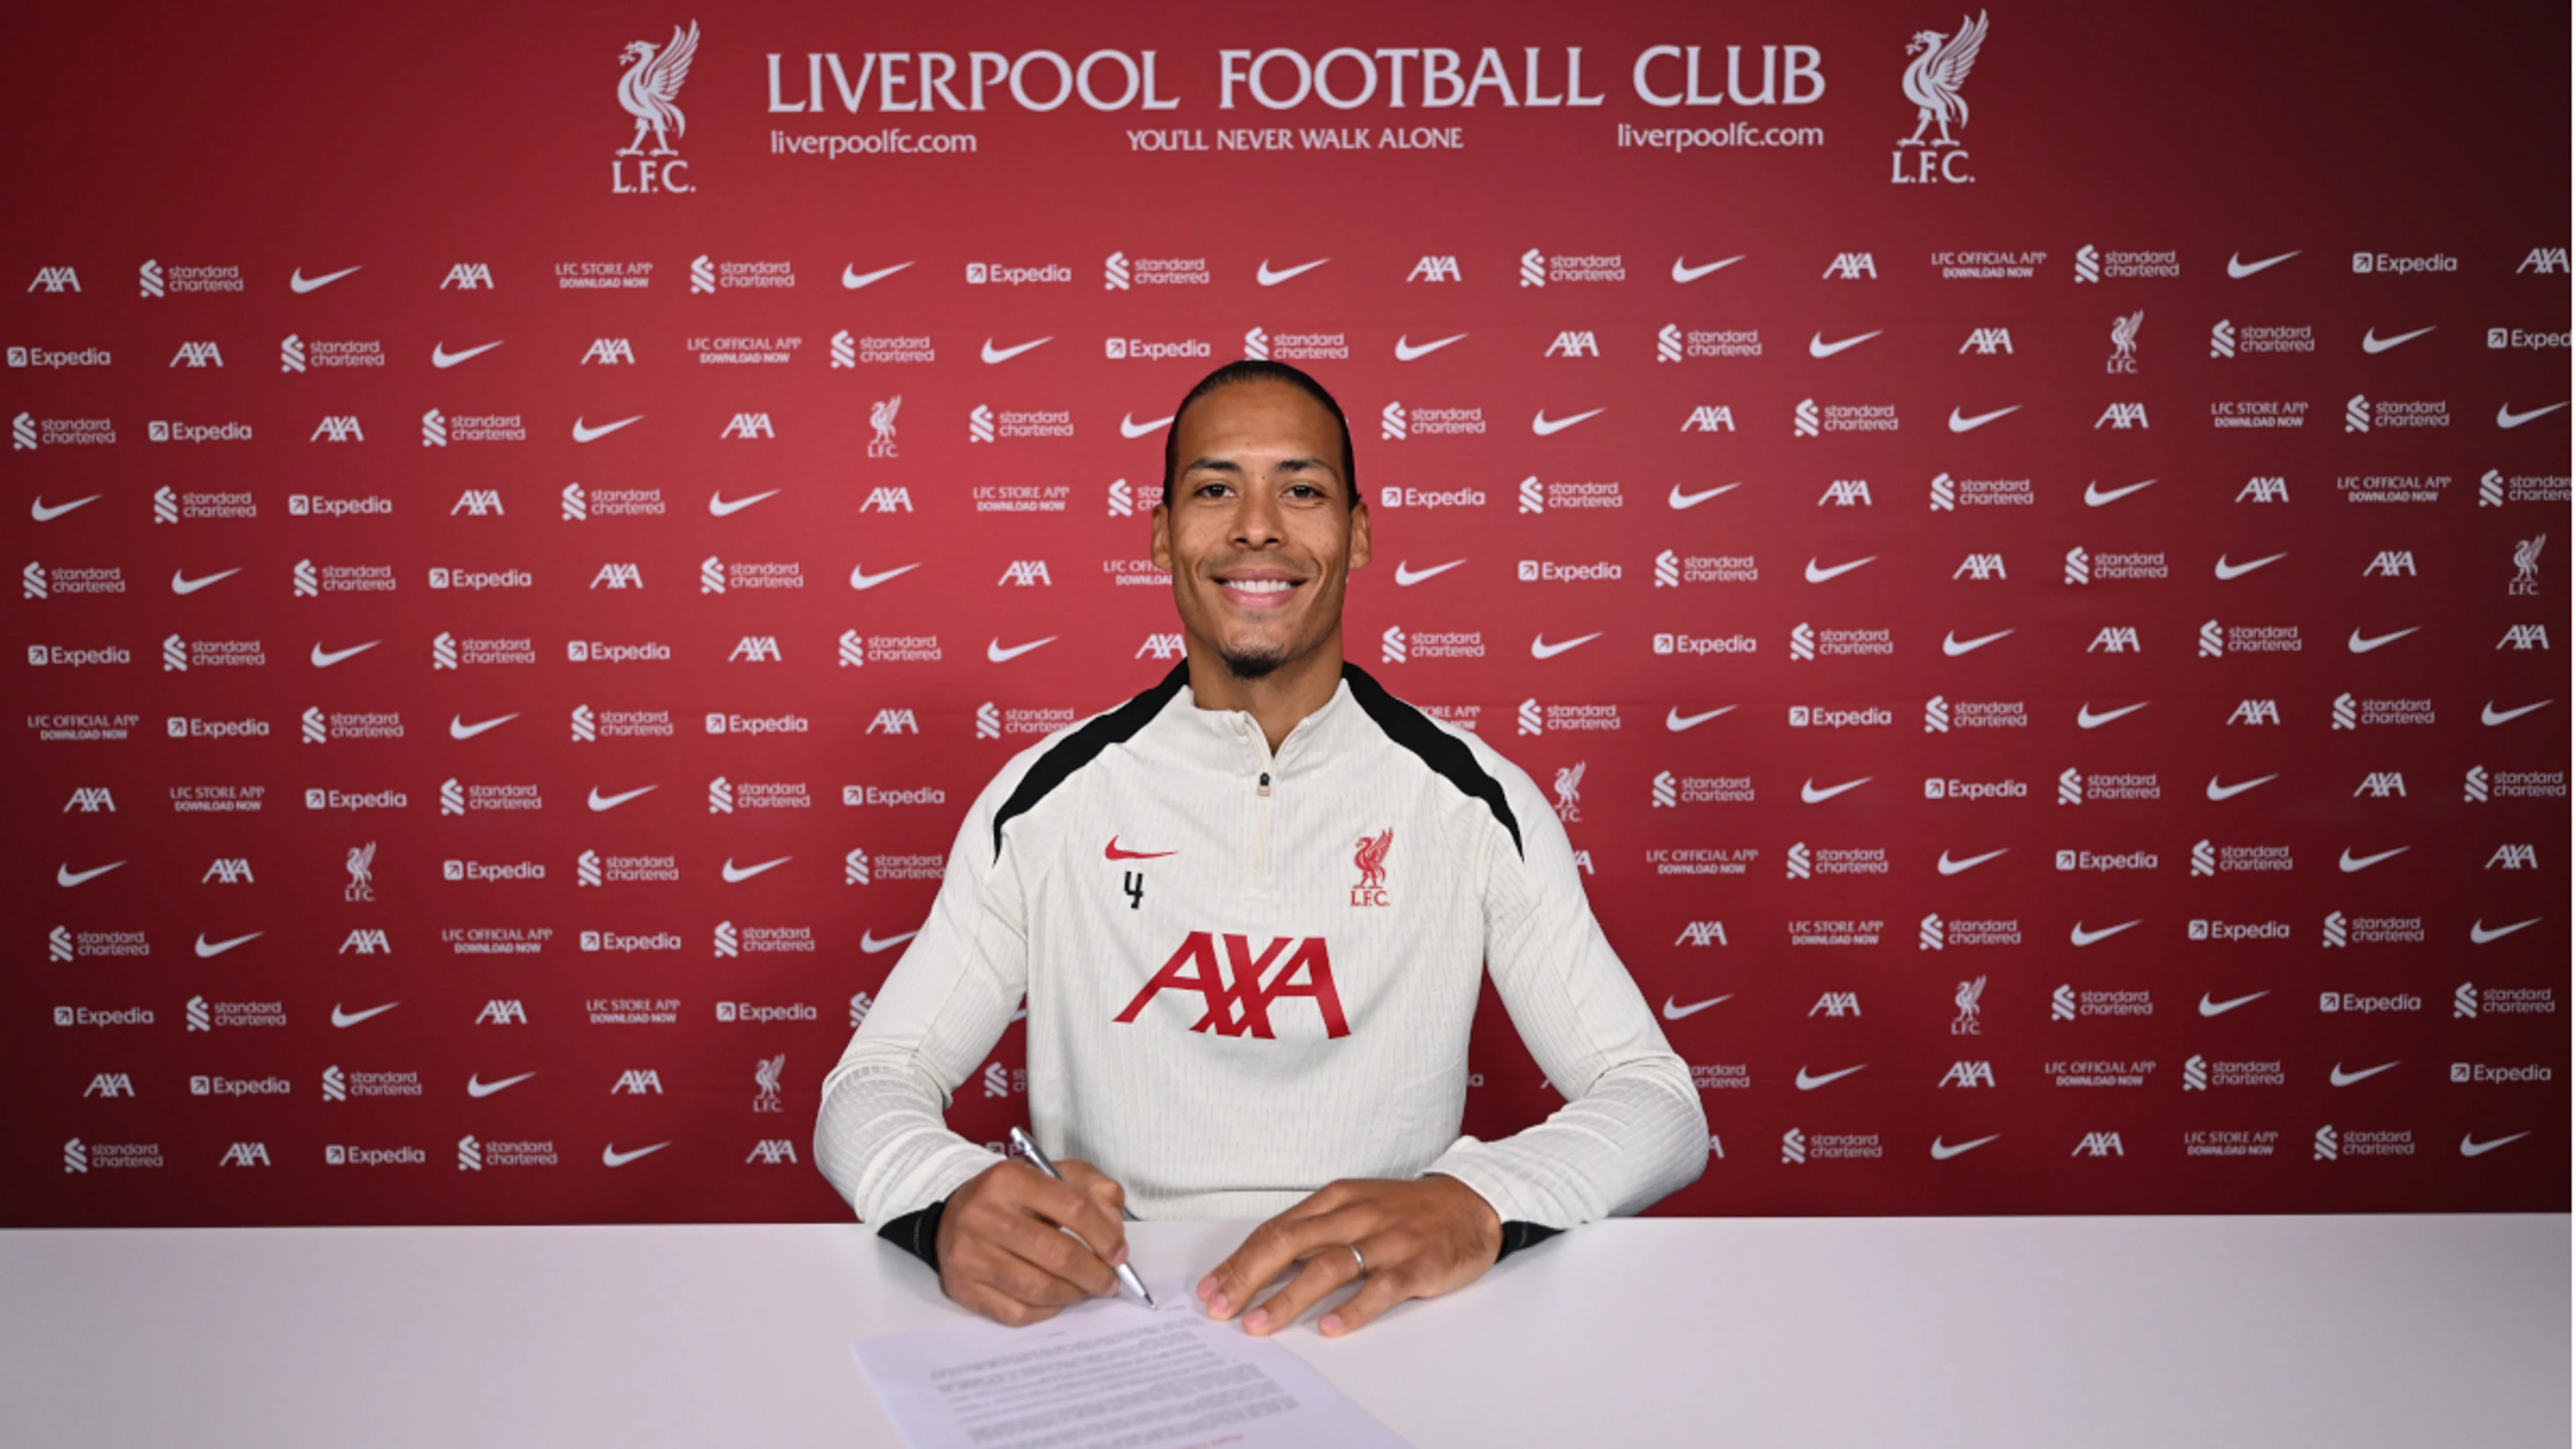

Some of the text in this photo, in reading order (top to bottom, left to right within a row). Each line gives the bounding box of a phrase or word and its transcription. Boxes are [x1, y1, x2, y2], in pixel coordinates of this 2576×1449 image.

[767, 45, 1825, 113] LIVERPOOL FOOTBALL CLUB
[771, 129, 977, 160] liverpoolfc.com
[1127, 127, 1464, 150] YOU'LL NEVER WALK ALONE
[1618, 122, 1823, 152] liverpoolfc.com
[612, 161, 696, 193] L.F.C.
[1891, 152, 1975, 183] L.F.C.
[1134, 258, 1205, 271] standard
[1823, 253, 1877, 279] AXA
[1931, 252, 2047, 265] LFC OFFICIAL APP
[2105, 250, 2176, 264] standard
[2377, 254, 2457, 275] Expedia
[2516, 248, 2569, 273] AXA
[169, 266, 239, 278] standard
[440, 264, 494, 289] AXA
[555, 262, 653, 275] LFC STORE APP
[990, 264, 1071, 285] Expedia
[1134, 271, 1210, 284] chartered
[1407, 256, 1461, 282] AXA
[1943, 268, 2033, 278] DOWNLOAD NOW
[2104, 264, 2179, 277] chartered
[28, 267, 81, 292] AXA
[170, 278, 244, 292] chartered
[560, 277, 649, 288] DOWNLOAD NOW
[687, 337, 802, 350] LFC OFFICIAL APP
[860, 336, 930, 349] standard
[1545, 331, 1599, 357] AXA
[1687, 330, 1758, 343] standard
[1960, 328, 2013, 354] AXA
[2511, 328, 2572, 350] Exped
[31, 347, 111, 369] Expedia
[170, 341, 223, 367] AXA
[581, 339, 635, 364] AXA
[700, 352, 790, 364] DOWNLOAD NOW
[860, 349, 934, 362] chartered
[1130, 339, 1211, 360] Expedia
[1687, 343, 1762, 356] chartered
[1411, 408, 1481, 421] standard
[1681, 406, 1735, 431] AXA
[2095, 403, 2149, 429] AXA
[2211, 402, 2308, 415] LFC STORE APP
[311, 416, 364, 441] AXA
[451, 415, 521, 427] standard
[721, 413, 775, 438] AXA
[1411, 421, 1486, 433] chartered
[2214, 417, 2304, 427] DOWNLOAD NOW
[172, 422, 252, 443] Expedia
[451, 427, 526, 440] chartered
[591, 489, 660, 501] standard
[973, 486, 1070, 499] LFC STORE APP
[1818, 480, 1872, 506] AXA
[1960, 479, 2030, 492] standard
[2235, 477, 2289, 502] AXA
[313, 496, 392, 517] Expedia
[451, 490, 504, 515] AXA
[591, 501, 665, 515] chartered
[860, 487, 913, 513] AXA
[977, 501, 1065, 511] DOWNLOAD NOW
[1405, 488, 1485, 509] Expedia
[1960, 492, 2033, 504] chartered
[1542, 561, 1621, 582] Expedia
[1684, 555, 1754, 568] standard
[1953, 554, 2006, 580] AXA
[2363, 551, 2416, 576] AXA
[453, 569, 532, 590] Expedia
[590, 564, 643, 588] AXA
[998, 561, 1051, 586] AXA
[1684, 568, 1758, 582] chartered
[462, 638, 531, 651] standard
[1135, 634, 1187, 659] AXA
[1677, 635, 1756, 655] Expedia
[2087, 627, 2140, 652] AXA
[2496, 625, 2549, 649] AXA
[51, 646, 130, 667] Expedia
[462, 651, 535, 663] chartered
[591, 642, 670, 663] Expedia
[729, 637, 782, 661] AXA
[600, 710, 668, 723] standard
[866, 709, 918, 734] AXA
[1813, 707, 1892, 728] Expedia
[2227, 700, 2279, 724] AXA
[191, 718, 269, 739] Expedia
[600, 723, 674, 736] chartered
[729, 714, 808, 735] Expedia
[738, 783, 806, 795] standard
[1948, 780, 2027, 800] Expedia
[2353, 772, 2406, 797] AXA
[64, 788, 115, 812] AXA
[329, 790, 407, 810] Expedia
[738, 795, 810, 808] chartered
[866, 786, 945, 807] Expedia
[1646, 849, 1758, 862] LFC OFFICIAL APP
[1816, 848, 1884, 860] standard
[2080, 851, 2157, 871] Expedia
[2485, 845, 2538, 869] AXA
[202, 859, 254, 883] AXA
[467, 861, 545, 882] Expedia
[1658, 863, 1746, 874] DOWNLOAD NOW
[1816, 860, 1888, 873] chartered
[1124, 871, 1143, 909] 4
[1350, 890, 1390, 907] L.F.C.
[743, 927, 810, 938] standard
[1675, 922, 1727, 946] AXA
[2211, 921, 2290, 941] Expedia
[339, 930, 390, 954] AXA
[603, 932, 681, 953] Expedia
[743, 938, 815, 951] chartered
[1112, 930, 1352, 1040] AXA
[476, 1000, 527, 1024] AXA
[739, 1003, 817, 1022] Expedia
[1809, 992, 1861, 1016] AXA
[2343, 994, 2421, 1014] Expedia
[77, 1007, 154, 1027] Expedia
[611, 1070, 663, 1093] AXA
[1939, 1061, 1995, 1087] AXA
[2473, 1064, 2551, 1084] Expedia
[84, 1073, 135, 1097] AXA
[213, 1077, 290, 1097] Expedia
[1811, 1134, 1878, 1145] standard
[2072, 1132, 2123, 1156] AXA
[220, 1142, 270, 1166] AXA
[348, 1146, 425, 1166] Expedia
[746, 1140, 797, 1165] AXA
[1811, 1145, 1882, 1158] chartered
